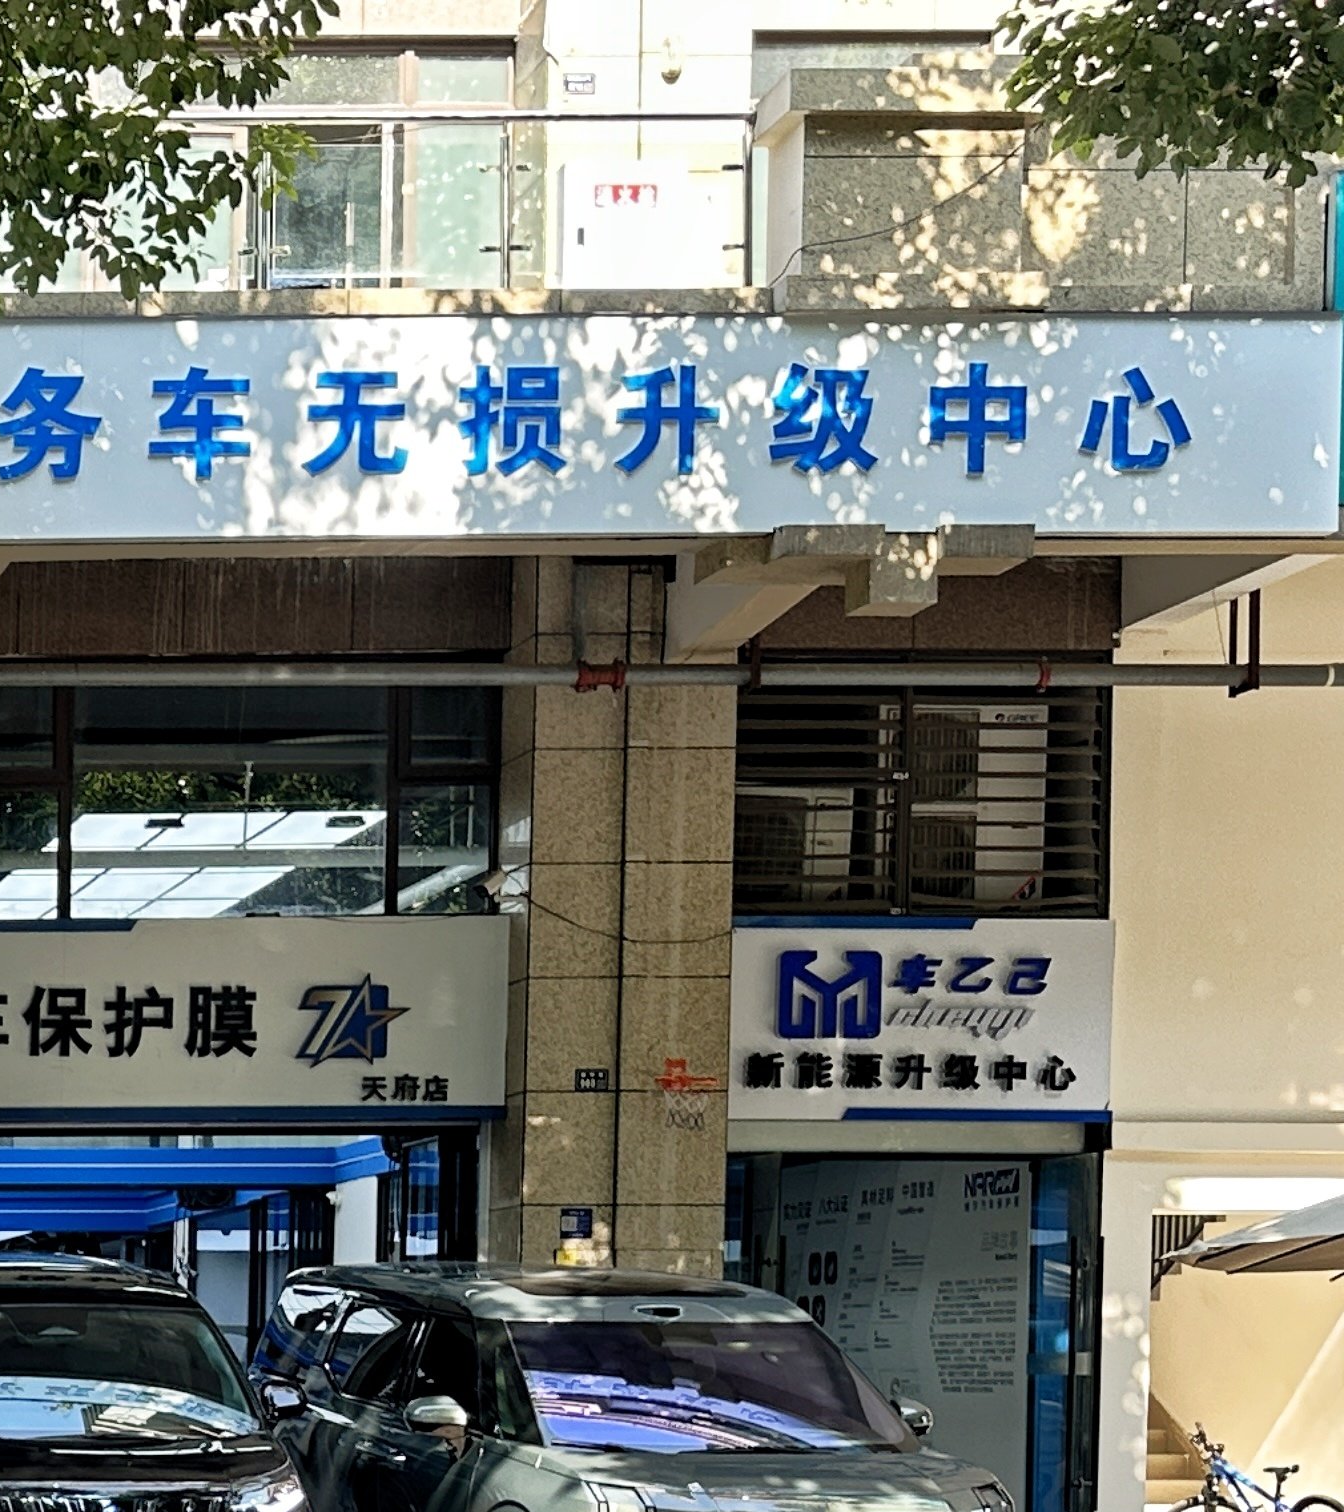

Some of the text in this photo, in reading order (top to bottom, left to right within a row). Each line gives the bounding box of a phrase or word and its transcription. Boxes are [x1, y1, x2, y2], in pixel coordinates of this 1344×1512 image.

[889, 954, 1052, 995] 车乙己
[361, 1074, 449, 1102] 天府店
[746, 1052, 1077, 1092] 新能源升级中心
